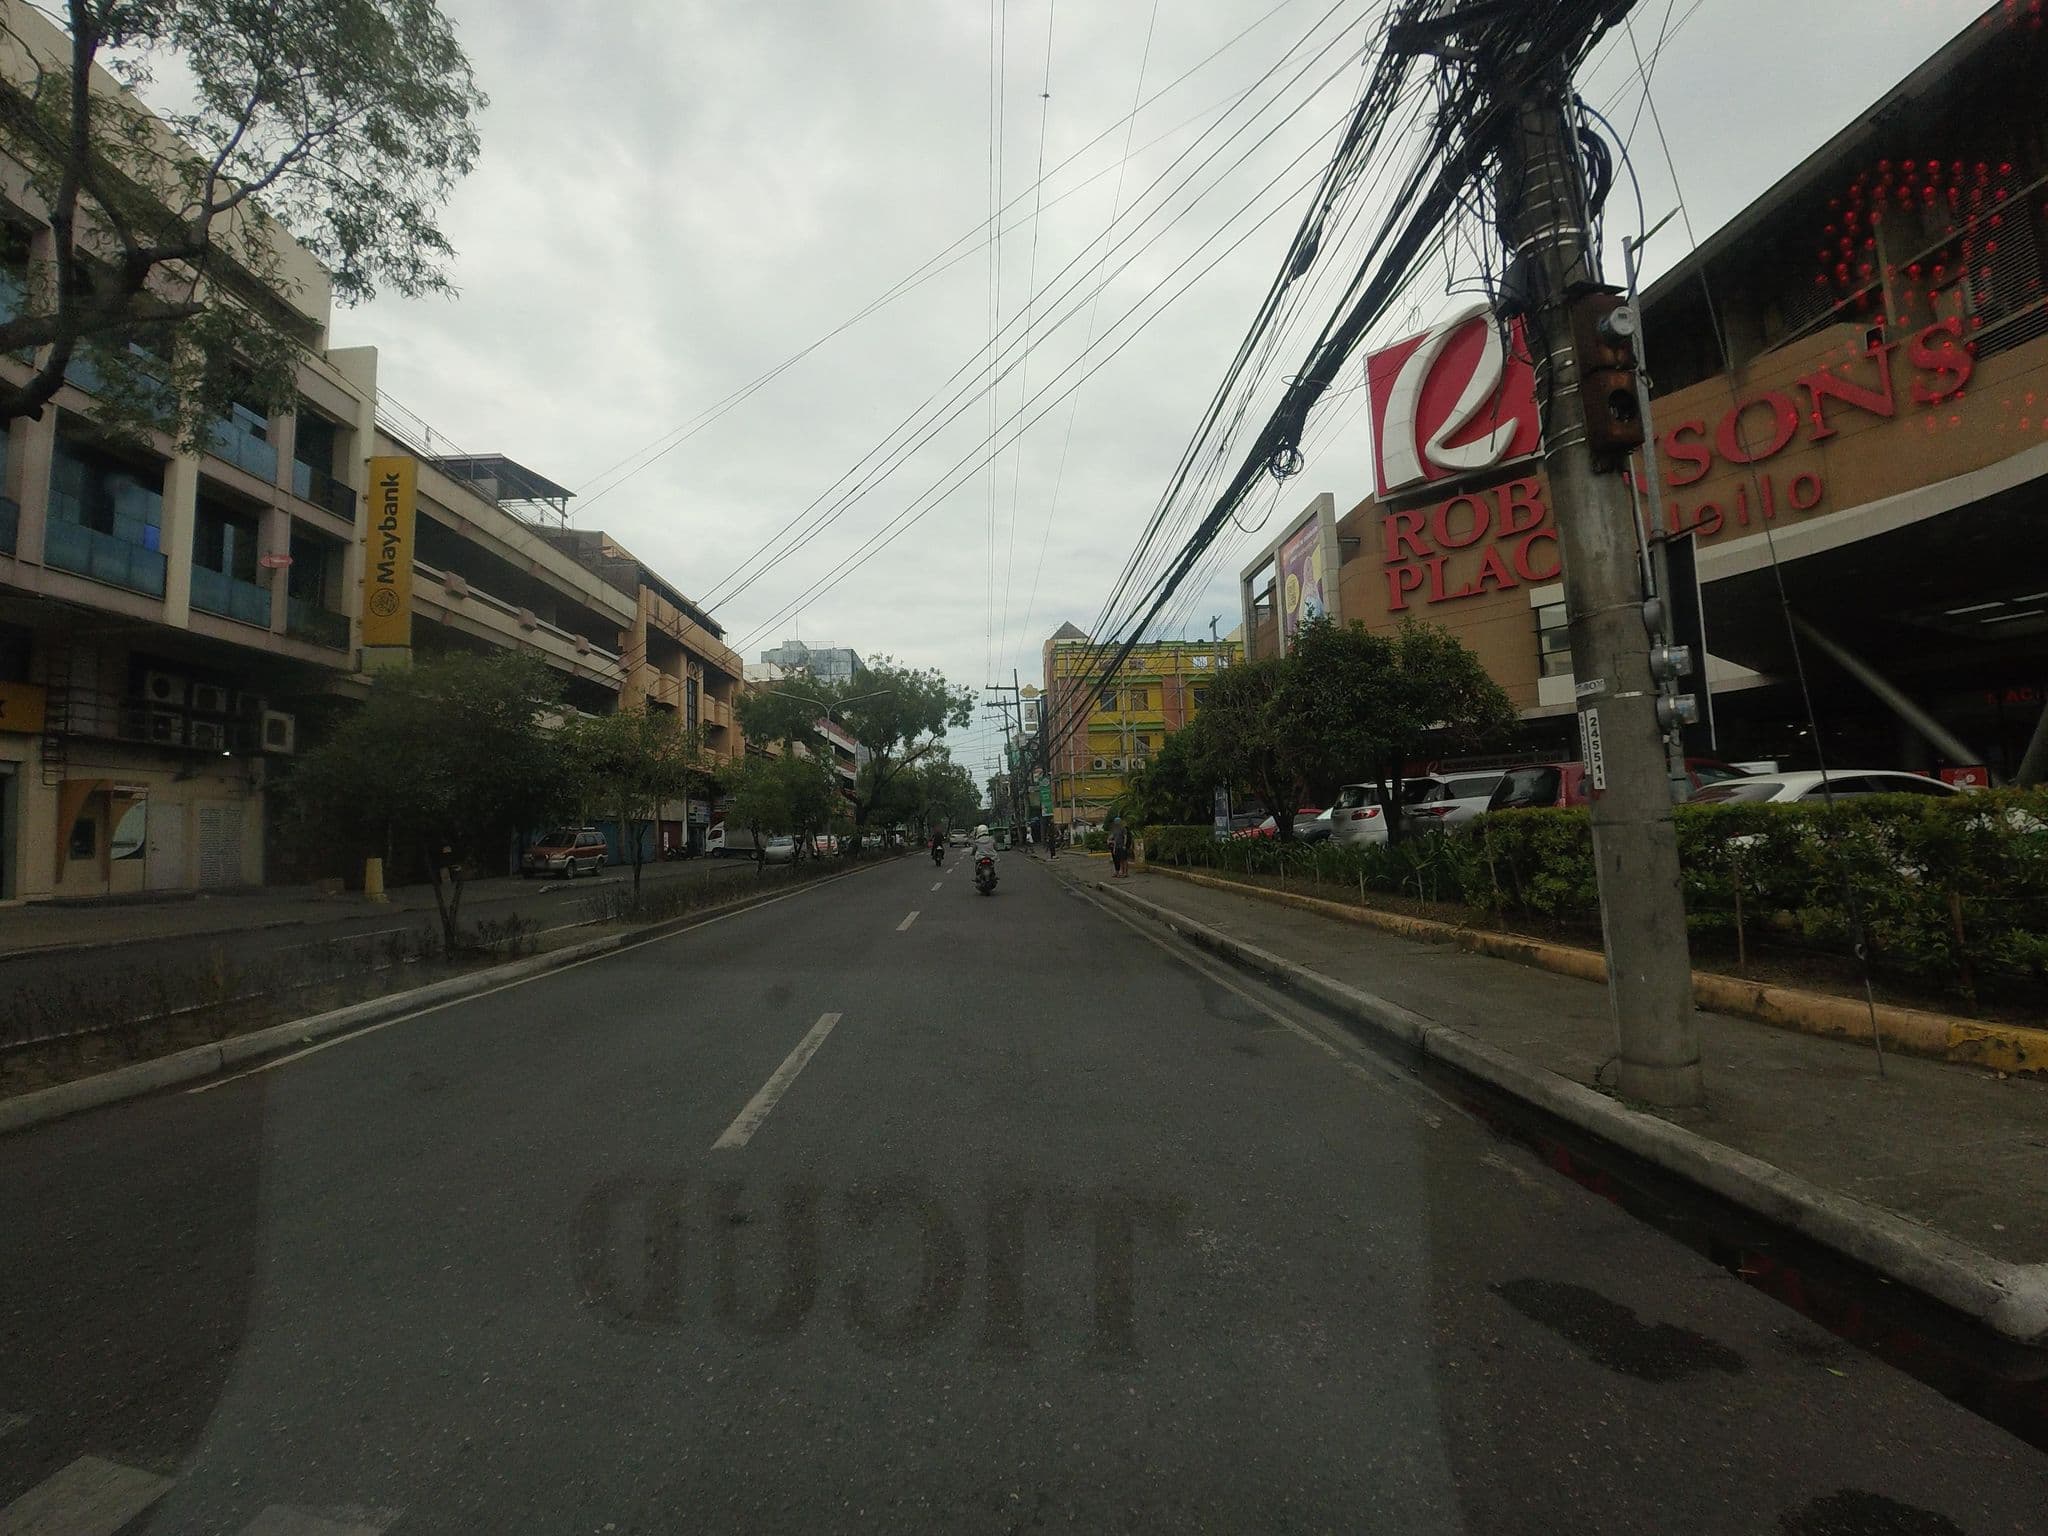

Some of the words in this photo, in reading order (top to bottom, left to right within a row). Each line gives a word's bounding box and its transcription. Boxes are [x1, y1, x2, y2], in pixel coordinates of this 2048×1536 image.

[377, 472, 401, 584] Maybank
[1384, 528, 1562, 612] PLAC
[1647, 471, 1823, 536] loilo
[1590, 716, 1603, 787] 245511
